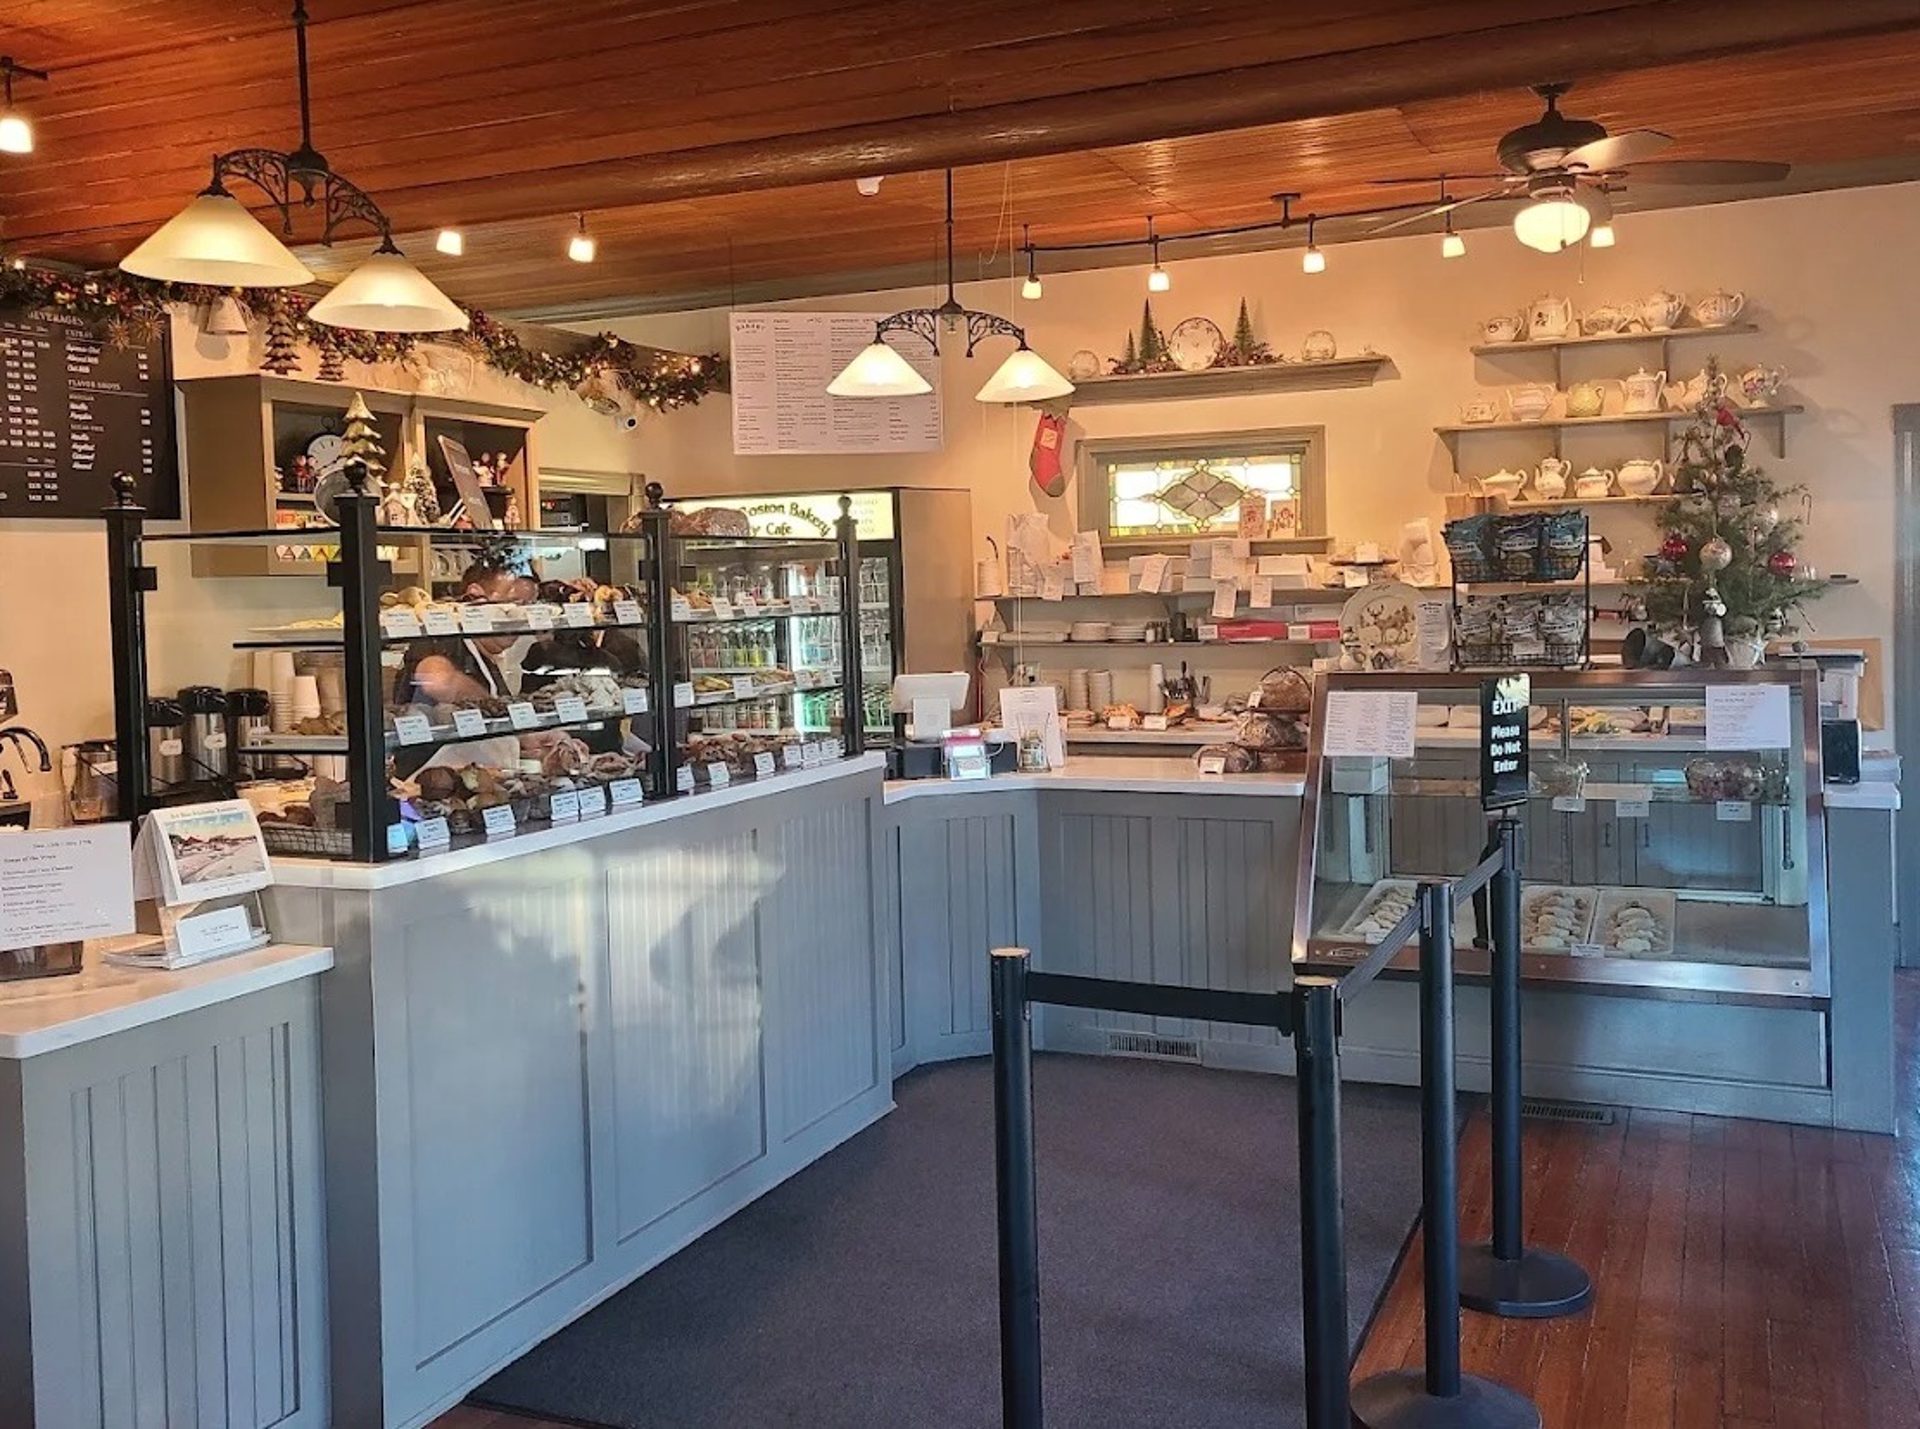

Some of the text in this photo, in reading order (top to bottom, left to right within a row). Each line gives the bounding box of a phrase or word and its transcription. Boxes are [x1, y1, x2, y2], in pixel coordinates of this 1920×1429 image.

[788, 502, 833, 537] Bakery
[766, 522, 793, 536] Cafe
[1492, 700, 1518, 715] EXIT
[1491, 725, 1520, 740] Please
[1490, 741, 1522, 757] Do Not
[1493, 760, 1519, 774] Enter
